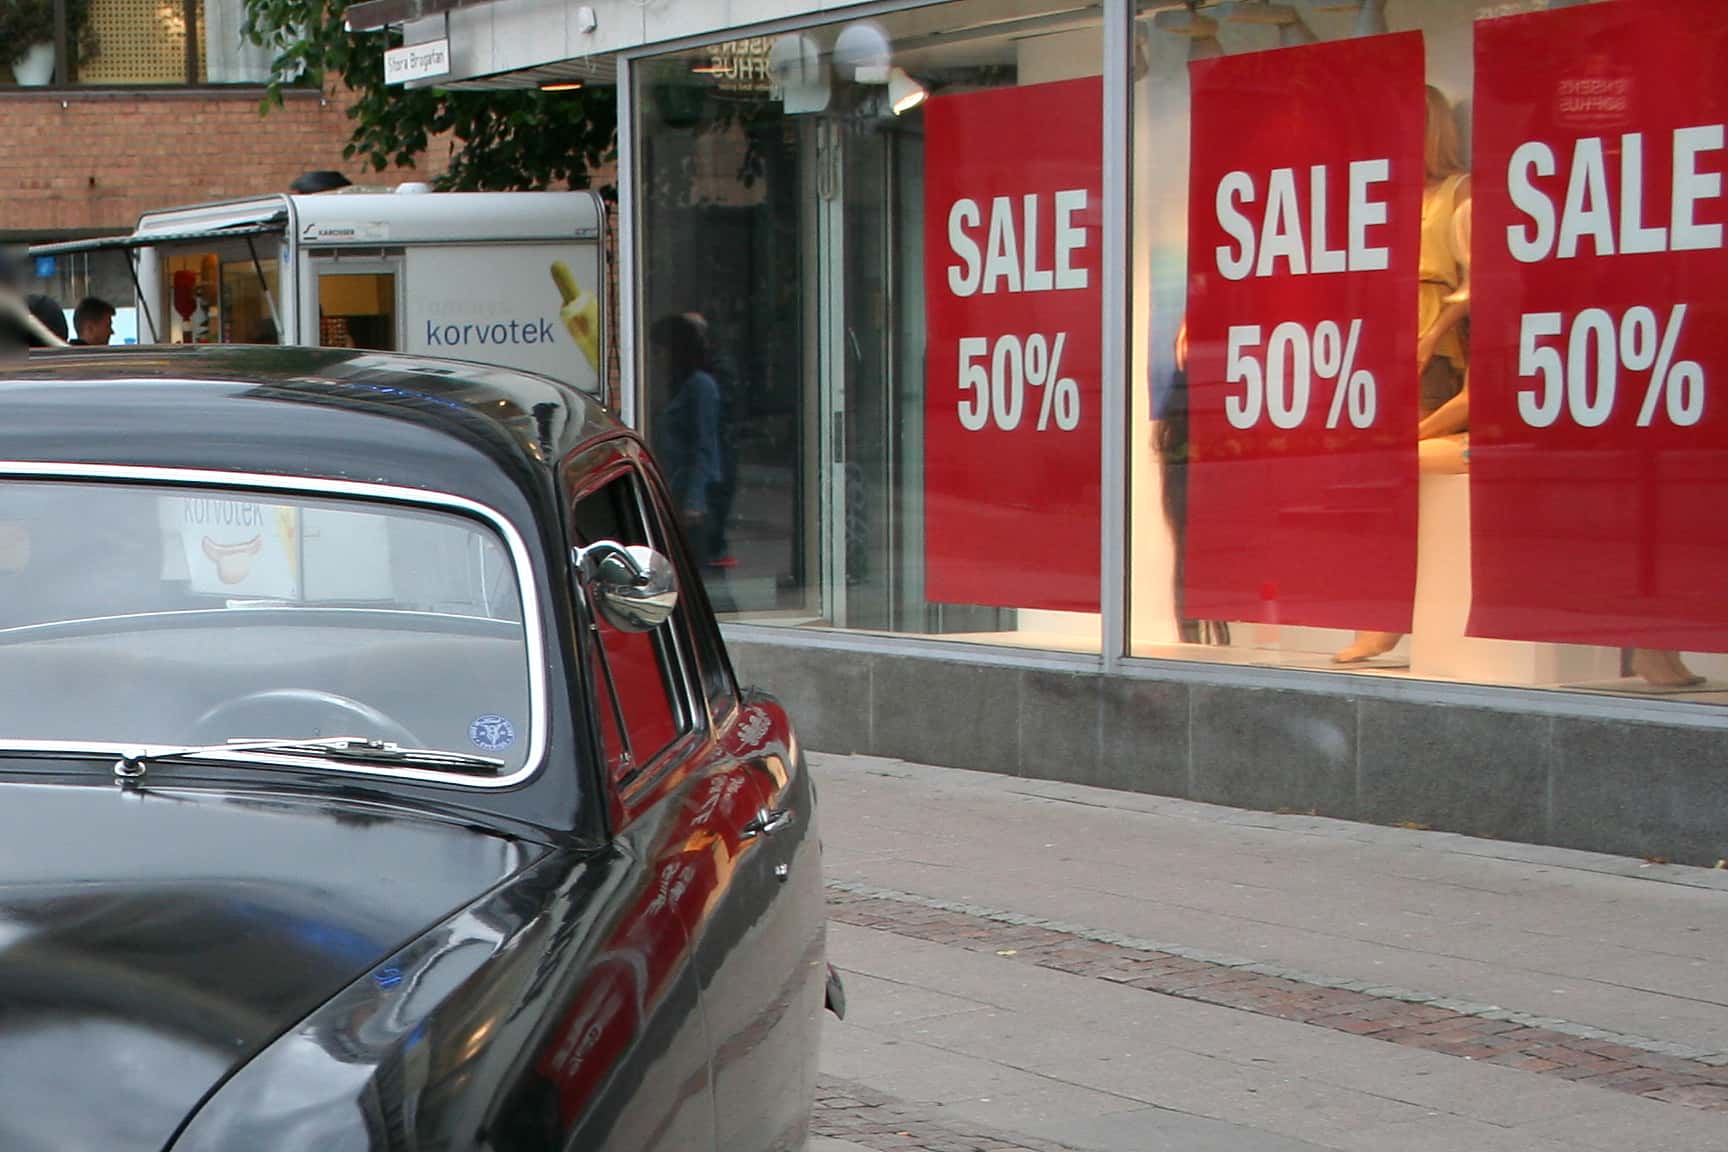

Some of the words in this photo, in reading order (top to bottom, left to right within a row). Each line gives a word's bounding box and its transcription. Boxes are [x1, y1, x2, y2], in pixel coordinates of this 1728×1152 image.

[947, 189, 1088, 297] SALE
[1216, 158, 1390, 281] SALE
[1506, 124, 1724, 264] SALE
[426, 318, 555, 346] korvotek
[957, 332, 1080, 432] 50%
[1225, 317, 1378, 430] 50%
[1516, 303, 1705, 429] 50%
